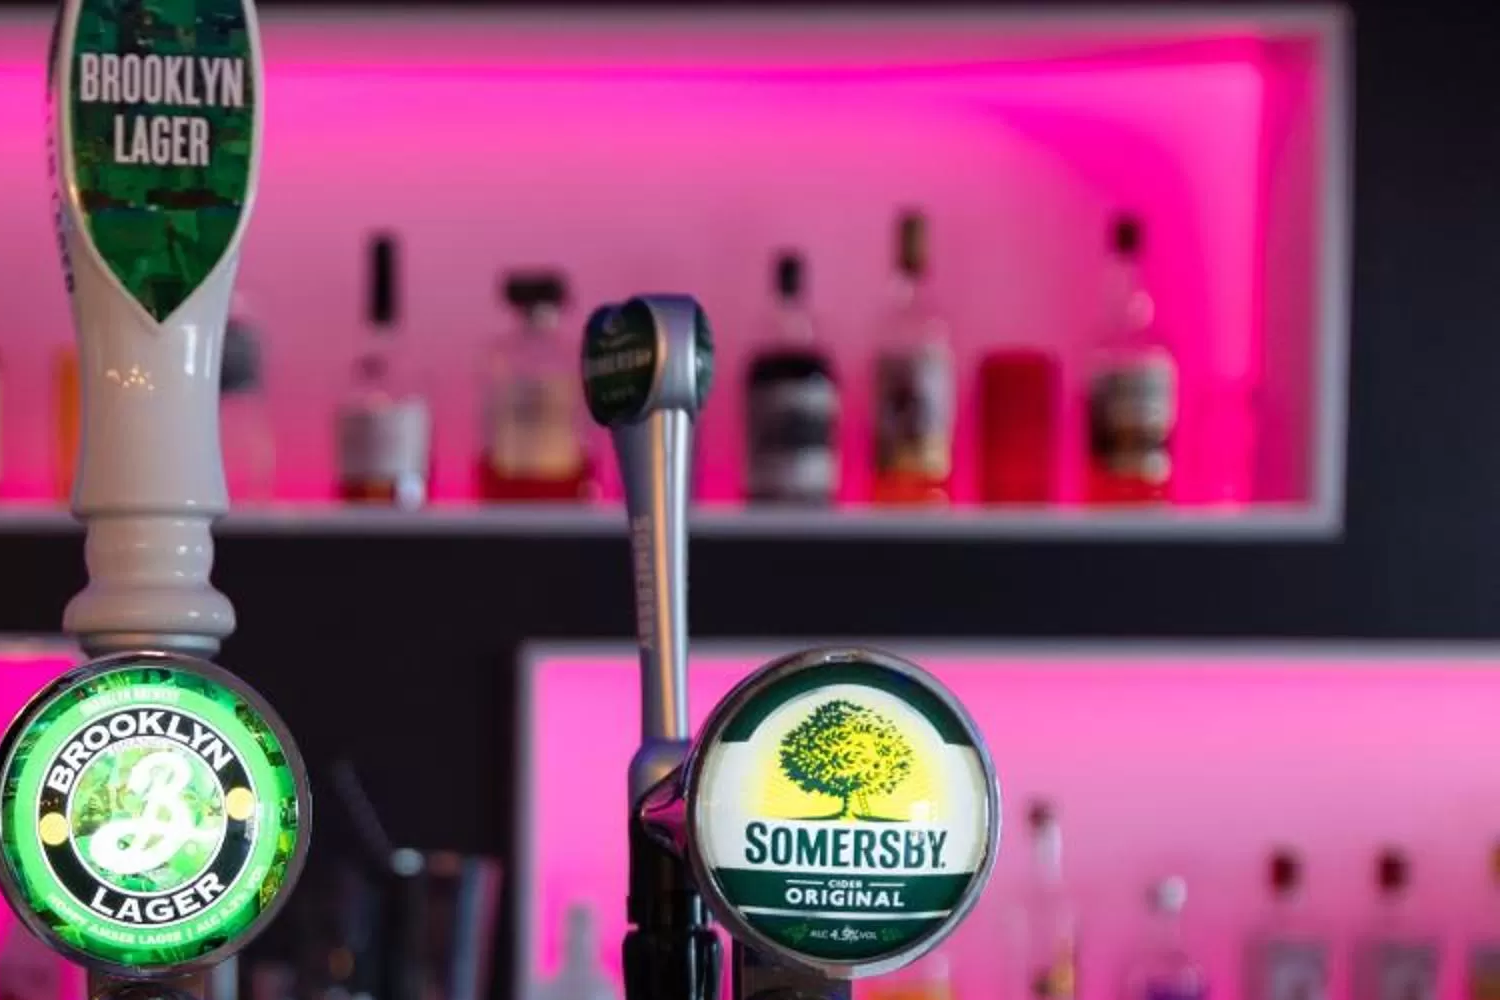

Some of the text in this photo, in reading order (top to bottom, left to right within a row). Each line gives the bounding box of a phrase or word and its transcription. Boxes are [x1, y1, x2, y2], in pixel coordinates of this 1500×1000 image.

[80, 53, 244, 107] BROOKLYN
[114, 115, 210, 166] LAGER
[46, 710, 234, 795] BROOKLYN
[744, 821, 949, 869] SOMERSBY
[90, 871, 226, 923] LAGER
[784, 887, 905, 907] ORIGINAL
[827, 879, 863, 889] CIDER
